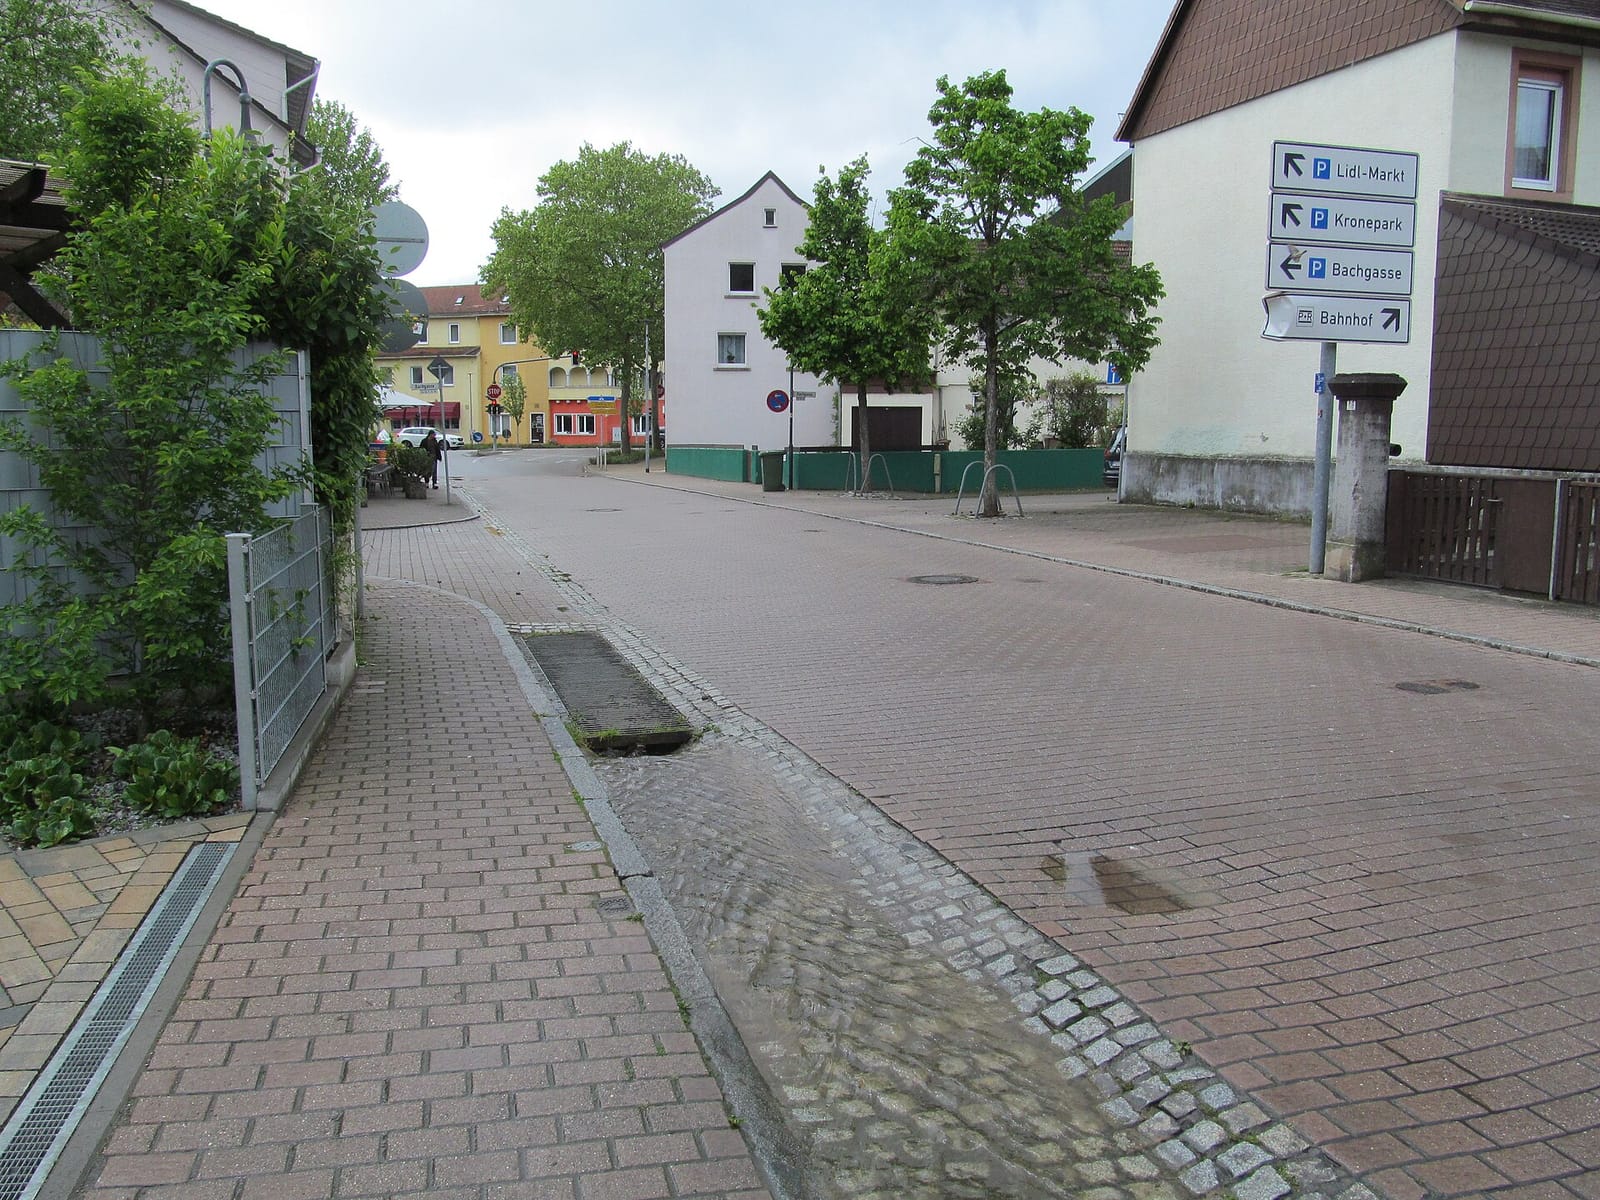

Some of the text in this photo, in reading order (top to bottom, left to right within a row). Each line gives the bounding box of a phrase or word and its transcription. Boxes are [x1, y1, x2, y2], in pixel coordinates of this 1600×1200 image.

[1316, 161, 1405, 182] P Lidl-Markt
[1314, 211, 1402, 232] P Kronepark
[1312, 261, 1401, 281] P Bachgasse
[1320, 310, 1374, 327] Bahnhof
